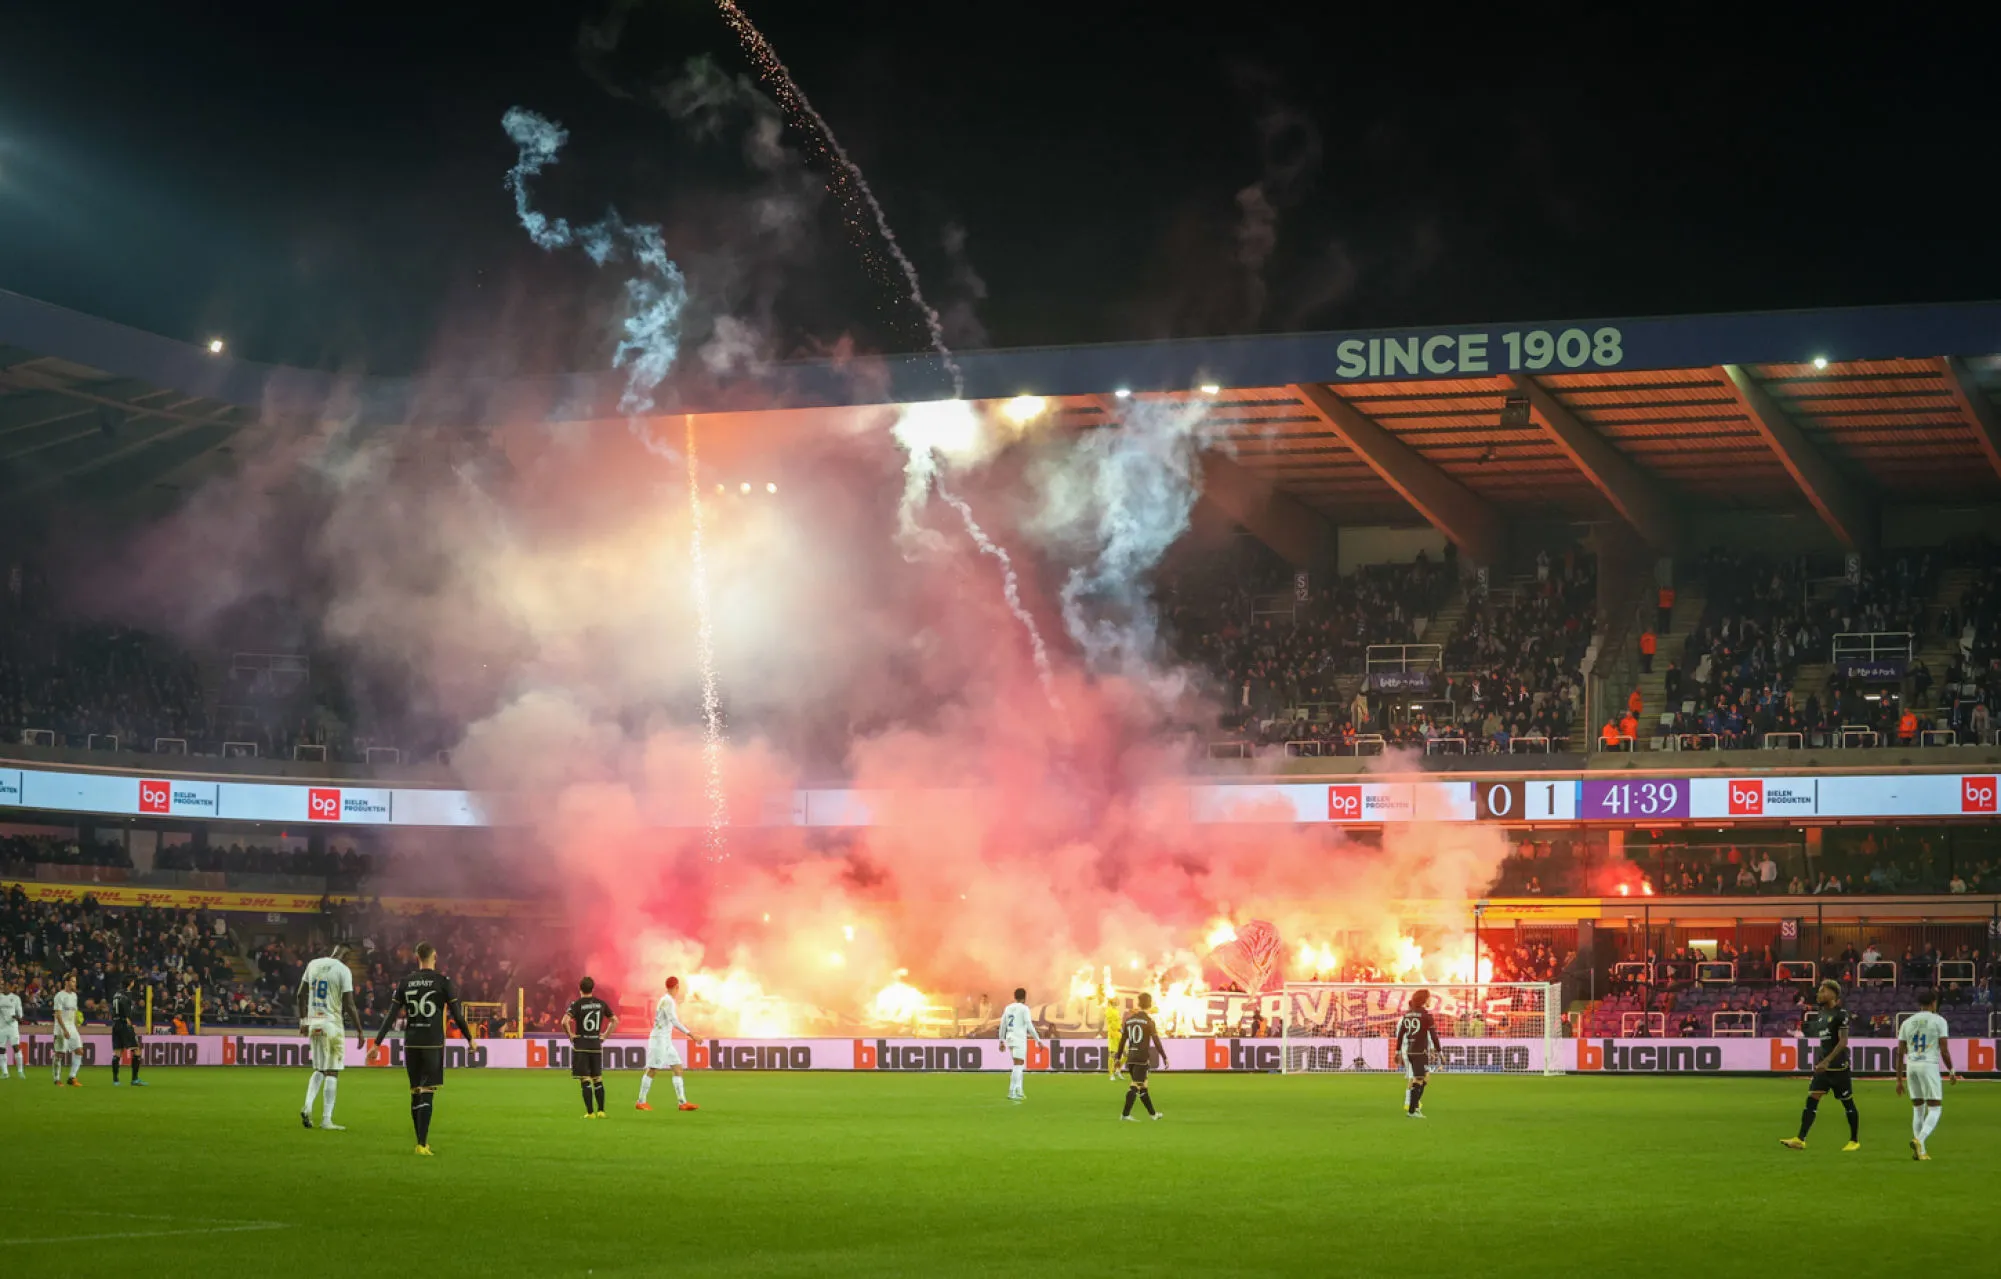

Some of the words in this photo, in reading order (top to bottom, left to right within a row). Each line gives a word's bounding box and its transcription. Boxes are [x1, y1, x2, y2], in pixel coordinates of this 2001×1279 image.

[1335, 333, 1489, 378] SINCE
[1502, 327, 1624, 371] 1908
[143, 785, 167, 808] bp
[173, 791, 197, 799] BIELEN
[173, 797, 213, 806] PRODUKTEN
[312, 792, 336, 816] bp
[1332, 791, 1358, 815] bp
[1488, 784, 1512, 816] 0
[1546, 783, 1555, 815] 1
[1602, 783, 1678, 814] 41:39
[1732, 785, 1759, 811] bp
[1966, 781, 1992, 807] bp
[344, 805, 386, 813] PRODUKTEN
[40, 888, 73, 898] DHL
[136, 893, 173, 902] DHL
[188, 896, 224, 905] DHL
[240, 897, 277, 907] DHL
[1782, 920, 1797, 937] S3
[312, 979, 328, 999] 18
[405, 989, 437, 1018] 56
[583, 1010, 600, 1032] 61
[1404, 1017, 1421, 1036] 99
[1127, 1024, 1144, 1044] 10
[366, 1038, 488, 1068] btno
[526, 1039, 646, 1069] btino
[687, 1039, 811, 1069] bticino
[853, 1039, 982, 1069] bticino
[1577, 1039, 1722, 1070] bticino
